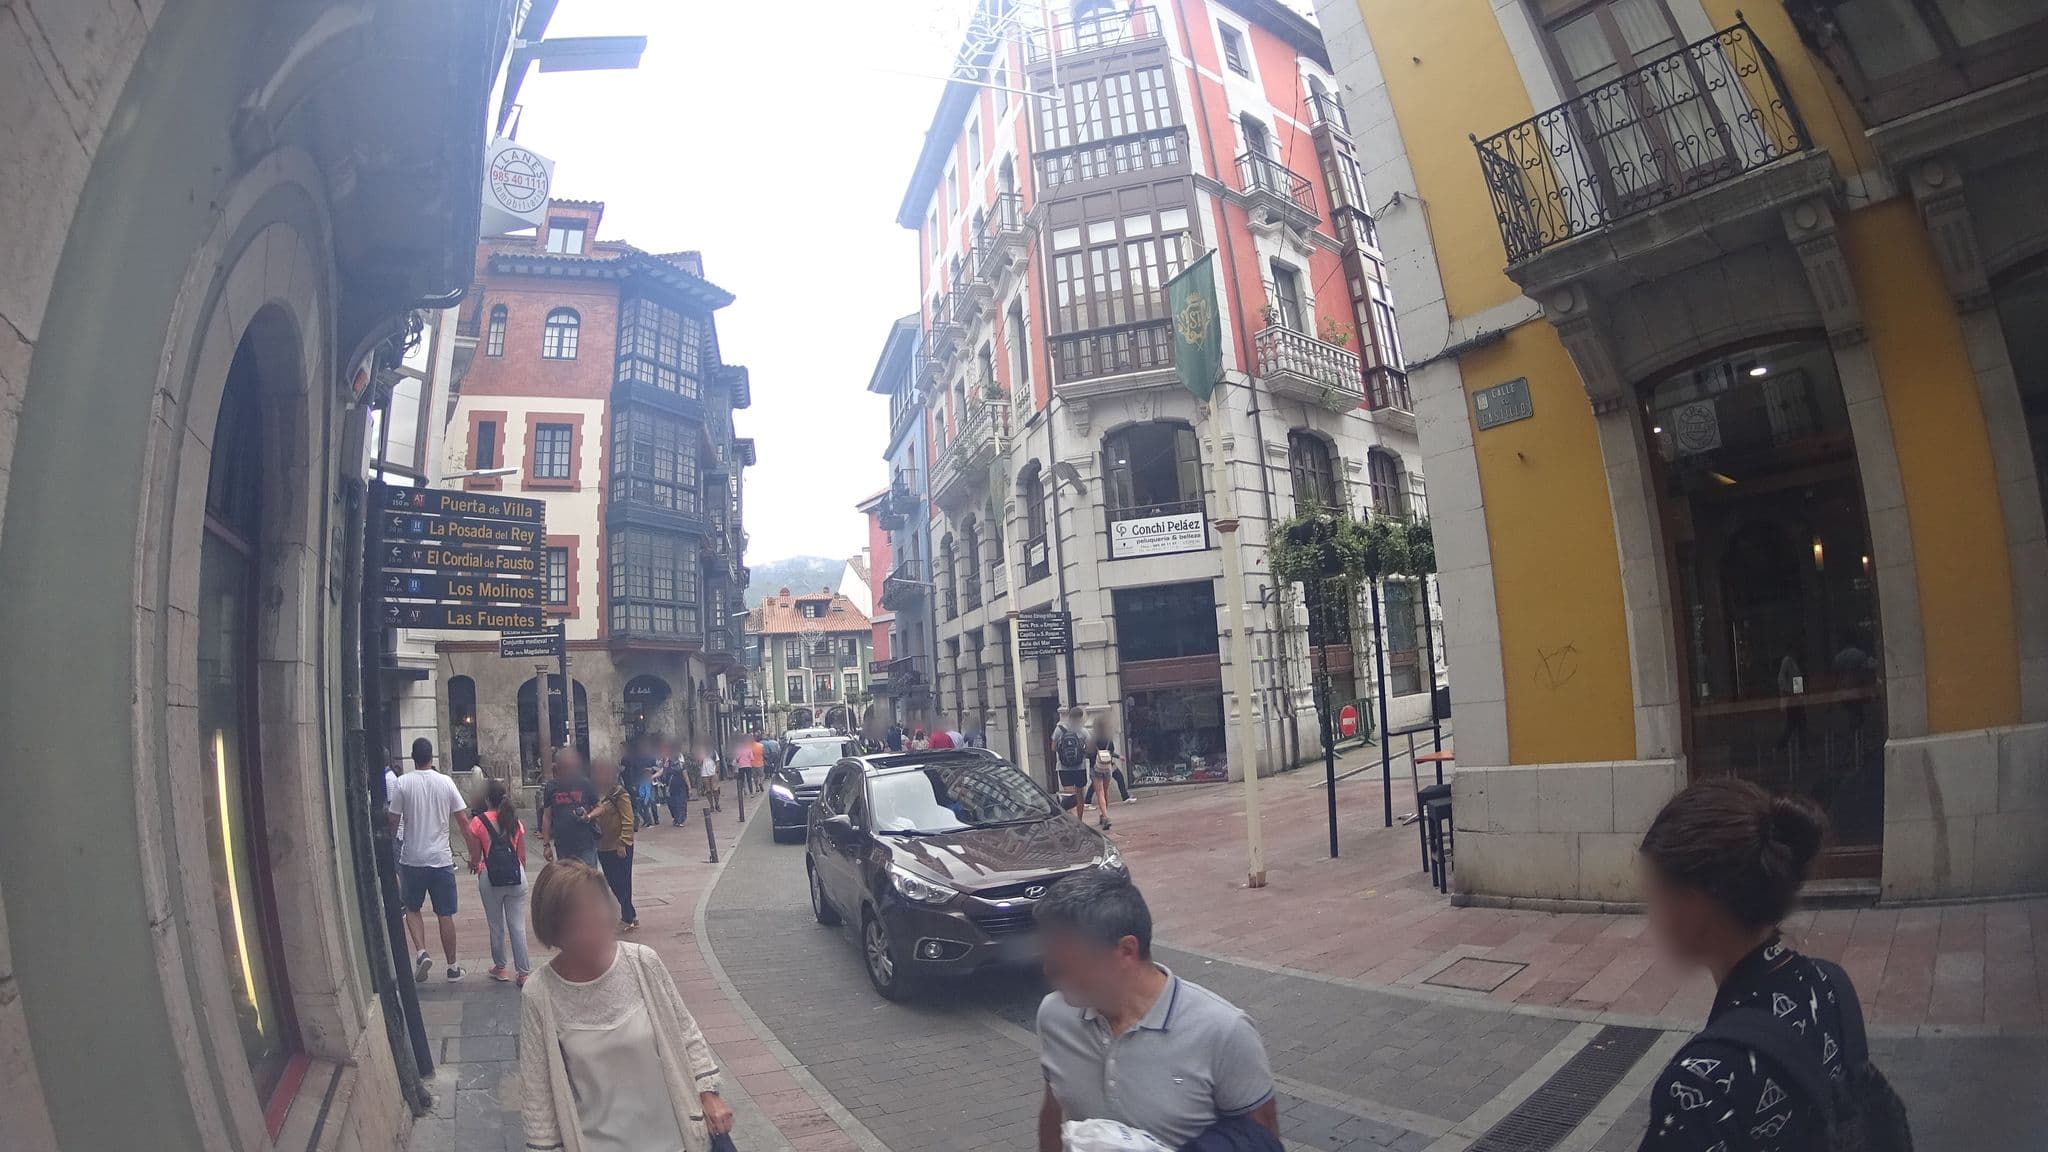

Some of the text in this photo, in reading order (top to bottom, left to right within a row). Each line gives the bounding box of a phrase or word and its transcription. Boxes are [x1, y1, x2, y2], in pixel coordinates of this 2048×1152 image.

[495, 151, 545, 178] LLANES
[493, 171, 510, 182] 985
[512, 175, 523, 186] 40
[1491, 384, 1516, 398] CALLE
[440, 495, 533, 518] Puerta de Villa
[429, 520, 535, 545] La Posada del Rey
[1132, 519, 1200, 536] Conchi Peláez
[427, 550, 534, 570] El Cordial de Fausto
[448, 580, 535, 599] Los Molinos
[447, 609, 535, 628] Las Fuentes
